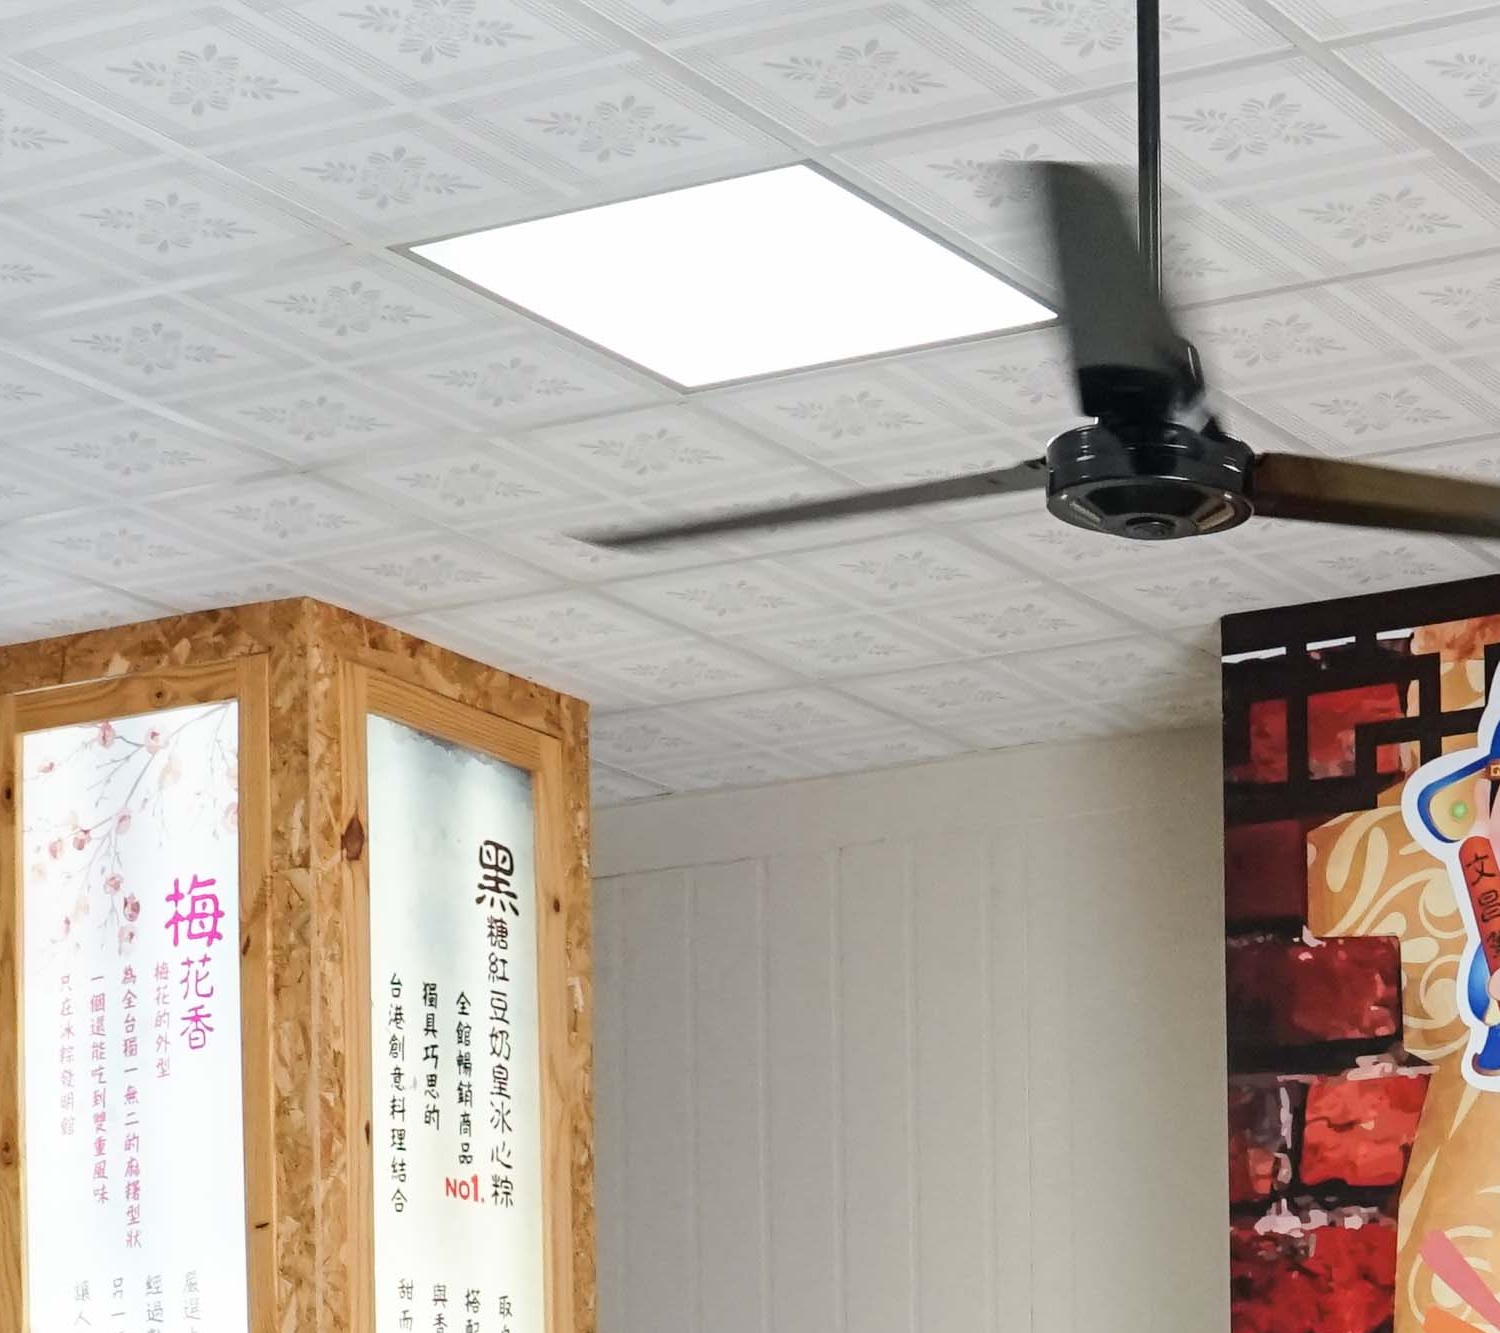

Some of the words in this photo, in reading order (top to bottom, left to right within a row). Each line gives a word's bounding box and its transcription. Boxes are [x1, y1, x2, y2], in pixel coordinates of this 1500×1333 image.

[154, 960, 171, 1080] 梅花的外型
[164, 873, 226, 1051] 梅花香
[474, 839, 520, 1208] 黑糖紅豆奶皇冰心粽
[387, 972, 408, 1213] 台港創意料理結合
[422, 981, 441, 1131] 獨具巧思的
[455, 990, 474, 1166] 全館暢銷商品
